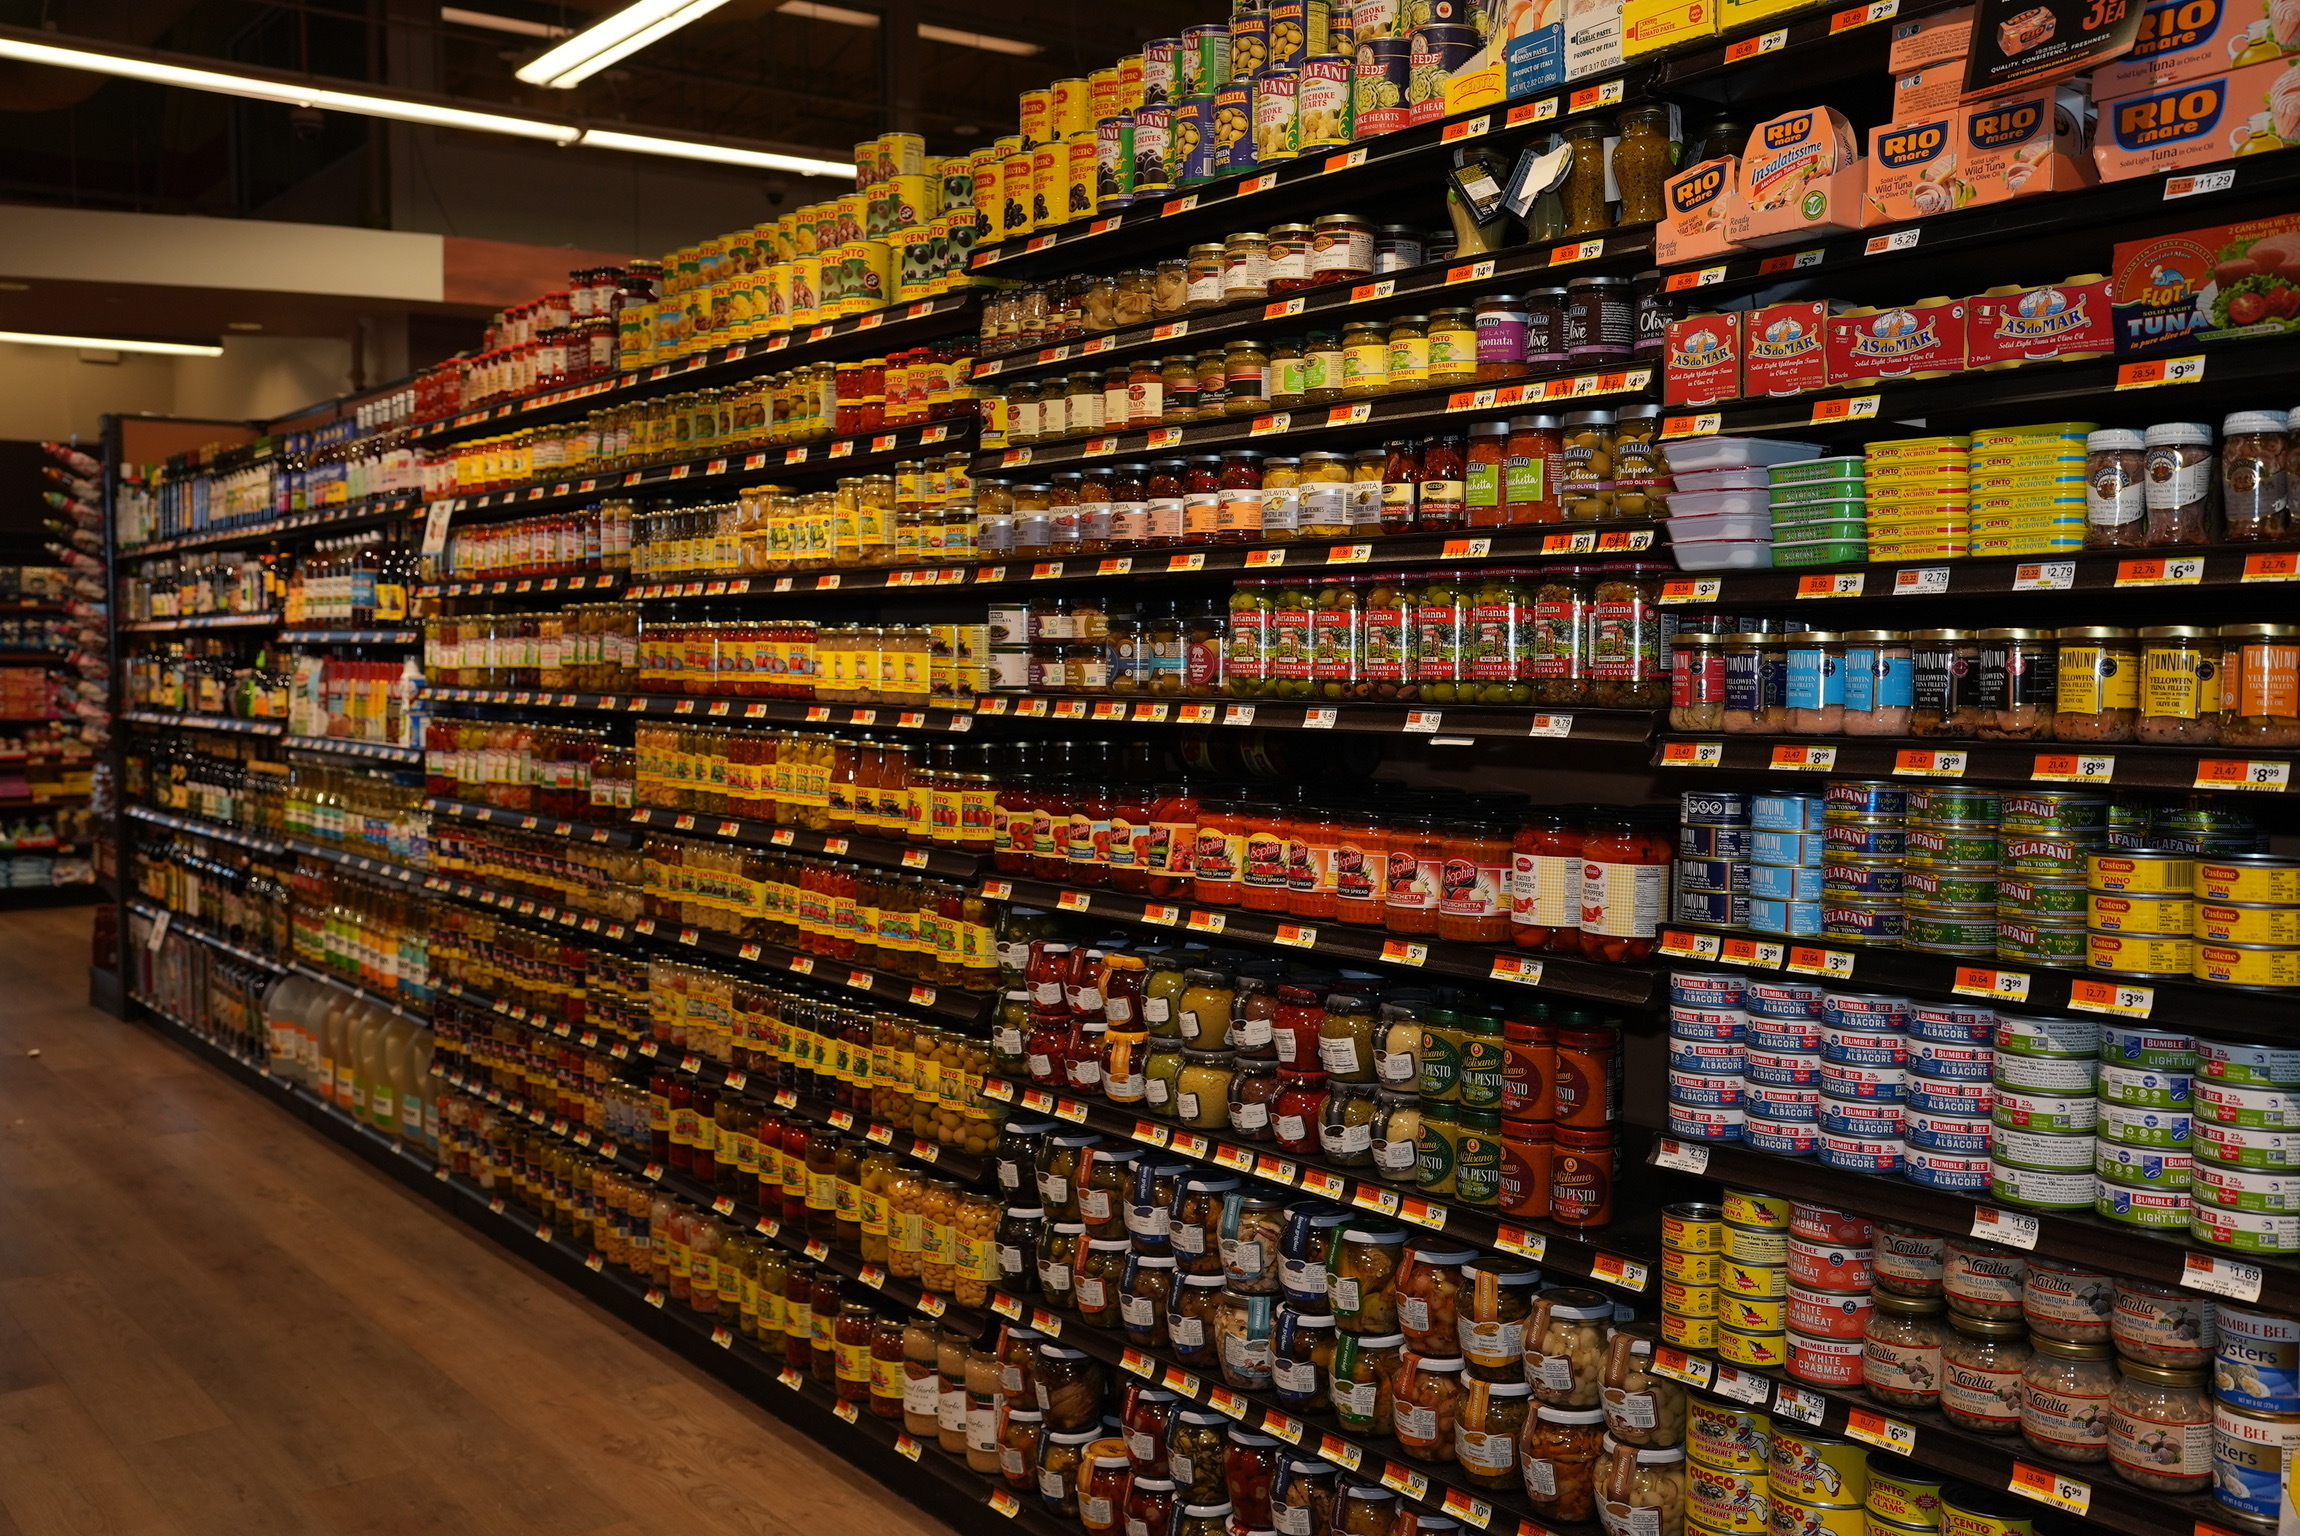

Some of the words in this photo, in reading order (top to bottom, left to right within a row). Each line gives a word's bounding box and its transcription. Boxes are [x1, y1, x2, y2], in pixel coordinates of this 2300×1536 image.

[2135, 30, 2198, 56] mare
[1574, 48, 1595, 59] PRODUCT
[1604, 41, 1618, 50] ITALY
[1991, 61, 2019, 73] QUALITY.
[2022, 45, 2070, 65] CONSISTENCY.
[2071, 33, 2111, 49] FRESHNESS.
[1513, 66, 1532, 77] PRODUCT
[1540, 59, 1553, 68] ITALY
[1581, 66, 1588, 74] WT
[1589, 63, 1599, 72] 3.17
[2147, 58, 2176, 73] Tuna
[1510, 85, 1518, 93] NET
[1519, 82, 1526, 90] WT
[2120, 87, 2218, 135] RIO
[1370, 113, 1399, 121] HEARTS
[1974, 107, 2037, 136] RIO
[1767, 119, 1810, 141] RIO
[1985, 124, 2026, 144] mare
[2137, 121, 2198, 144] mare
[1774, 132, 1801, 145] mare
[1884, 129, 1941, 156] RIO
[1894, 148, 1929, 163] mare
[2120, 157, 2134, 168] Solid
[2135, 155, 2148, 166] Light
[2150, 147, 2178, 162] Tuna
[1751, 142, 1821, 186] Insalatissime
[1965, 164, 1983, 176] Wild
[1984, 161, 2006, 173] Tuna
[1761, 172, 1782, 189] Mexican
[1797, 157, 1811, 167] Salad
[1893, 174, 1908, 183] Light
[2194, 170, 2231, 187] $11.29
[1677, 171, 1720, 200] RIO
[1875, 182, 1891, 194] Wild
[1893, 180, 1912, 192] Tuna
[1686, 190, 1712, 209] mare
[1730, 216, 1750, 227] Ready
[2235, 225, 2256, 234] CANS
[2259, 220, 2273, 228] Net
[1894, 233, 1917, 245] $5.29
[2235, 232, 2266, 242] Drained
[1658, 240, 1677, 252] Ready
[2143, 309, 2165, 317] SOLID
[2169, 305, 2191, 313] LIGHT
[2127, 310, 2210, 336] TUNA
[1429, 335, 1450, 343] CENTO
[2139, 337, 2157, 348] pure
[2159, 332, 2178, 343] olive
[2132, 367, 2156, 380] 28.54
[1988, 436, 2014, 445] CENTO
[2018, 438, 2057, 446] ANCHOVIES
[1620, 445, 1651, 455] DELALLO
[1877, 449, 1898, 457] CENTO
[1903, 450, 1936, 458] ANCHOVIES
[1569, 472, 1600, 480] Cheese
[1616, 465, 1655, 479] Jalapeño
[1877, 468, 1899, 476] CENTO
[1986, 478, 2011, 488] CENTO
[1264, 490, 1291, 498] COLAVITA
[946, 526, 964, 534] CENTO
[1984, 539, 2008, 547] CENTO
[2133, 565, 2156, 574] 32.76
[2261, 560, 2286, 569] 32.76
[1924, 572, 1947, 582] $2.79
[2048, 566, 2073, 577] $2.79
[2150, 652, 2194, 672] TONNINO
[2247, 649, 2295, 671] TONNINO
[2149, 677, 2193, 685] YELLOWFIN
[2247, 674, 2295, 683] YELLOWFIN
[1553, 718, 1571, 727] $9.79
[2048, 760, 2069, 769] 21.47
[2214, 766, 2237, 776] 21.47
[2001, 800, 2056, 817] SCLAFANI
[1250, 842, 1280, 859] Sophia
[2008, 841, 2072, 859] SCLAFANI
[2099, 862, 2132, 872] Pastene
[1445, 867, 1475, 883] Sophia
[2204, 870, 2236, 879] Pastene
[2100, 876, 2131, 885] TONNO
[2207, 884, 2230, 893] TUNA
[1442, 900, 1481, 911] BRUSCHETTA
[1822, 911, 1873, 927] SCLAFANI
[1921, 928, 1942, 936] TONNO
[2092, 940, 2119, 950] Pastene
[2094, 954, 2114, 962] TUNA
[1680, 980, 1706, 988] BUMBLE
[1761, 989, 1789, 998] BUMBLE
[1797, 991, 1812, 999] BEE
[2085, 988, 2107, 998] 12.77
[1683, 995, 1722, 1003] ALBACORE
[1764, 1005, 1806, 1014] ALBACORE
[1840, 1002, 1867, 1011] BUMBLE
[1875, 1004, 1891, 1012] BEE
[1842, 1017, 1885, 1026] ALBACORE
[1426, 1066, 1451, 1077] PESTO
[1689, 1147, 1707, 1157] $2.79
[1829, 1141, 1858, 1151] BUMBLE
[1865, 1145, 1881, 1153] BEE
[1832, 1156, 1875, 1165] ALBACORE
[1554, 1185, 1564, 1198] RED
[1567, 1188, 1595, 1201] PESTO
[2137, 1195, 2172, 1206] BUMBLE
[2012, 1217, 2037, 1230] $1.69
[2138, 1214, 2165, 1224] LIGHT
[2230, 1266, 2259, 1281] $1.69
[2225, 1333, 2247, 1343] WHOLE
[1800, 1340, 1829, 1351] BUMBLE
[1807, 1352, 1841, 1364] WHITE
[1799, 1360, 1851, 1376] CRABMEAT
[1748, 1376, 1768, 1389] $2.89
[1803, 1394, 1824, 1408] $4.29
[1692, 1405, 1737, 1428] CUOCO
[1706, 1446, 1732, 1458] SARDINES
[1718, 1441, 1750, 1452] MACARONI
[1690, 1466, 1735, 1490] CUOCO
[1874, 1481, 1904, 1496] CENTO
[1873, 1499, 1905, 1514] CLAMS
